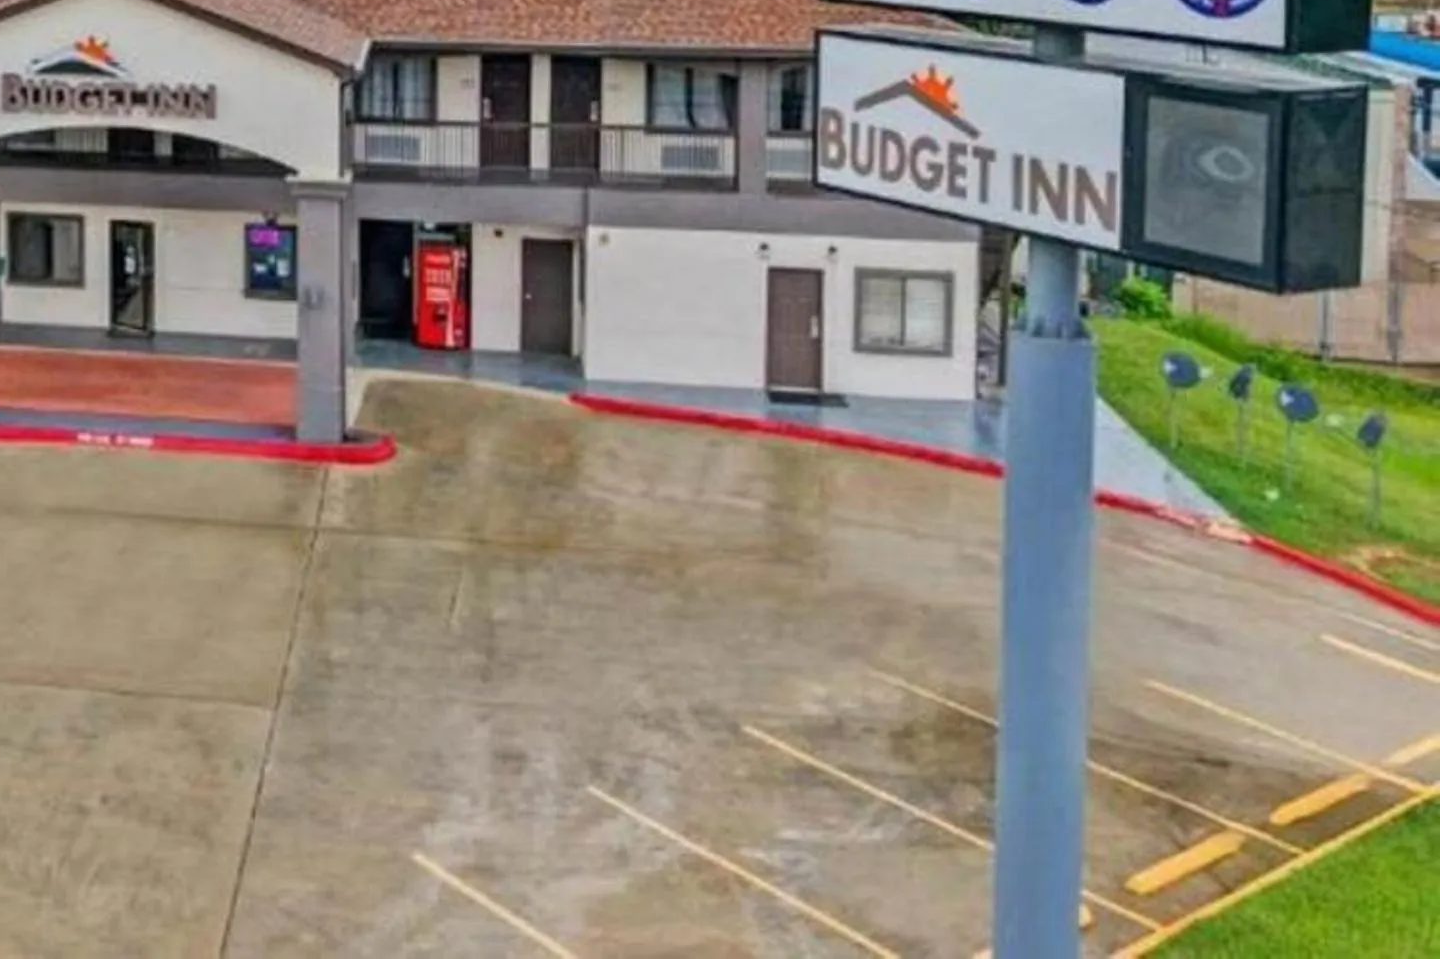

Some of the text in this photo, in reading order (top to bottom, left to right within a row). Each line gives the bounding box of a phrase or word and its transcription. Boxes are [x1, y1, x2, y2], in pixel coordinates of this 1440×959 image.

[0, 72, 217, 119] BUDGET INN
[818, 106, 1118, 232] BUDGET INN
